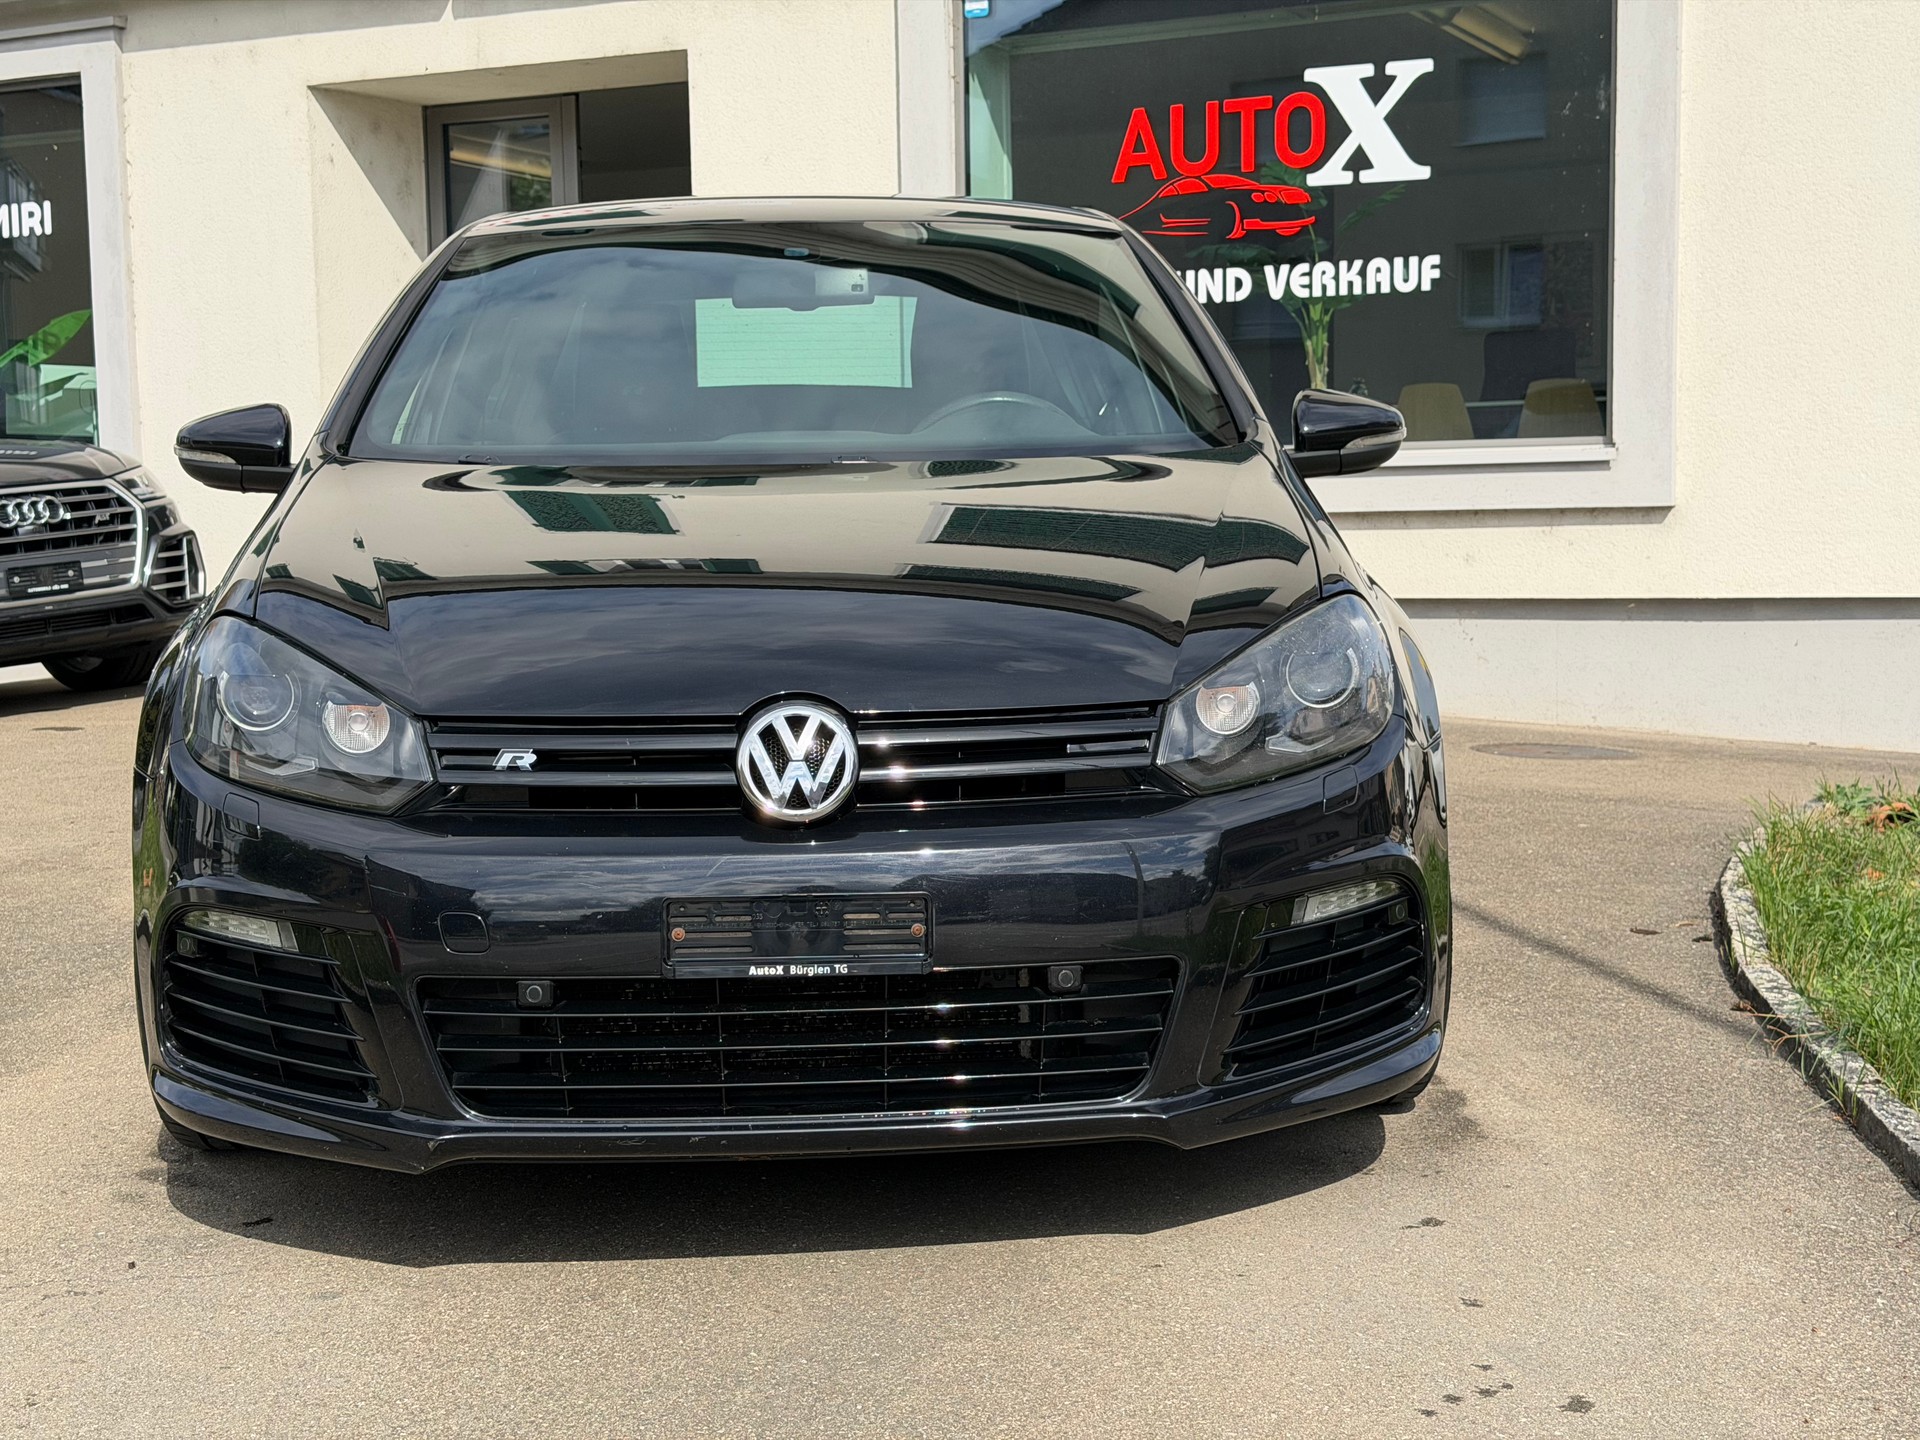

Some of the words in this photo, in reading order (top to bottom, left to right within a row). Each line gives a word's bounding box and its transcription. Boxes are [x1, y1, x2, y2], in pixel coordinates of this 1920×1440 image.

[1264, 254, 1441, 301] VERKAUF
[493, 748, 538, 772] R
[749, 712, 847, 810] VW
[748, 965, 784, 976] AutoX
[789, 964, 831, 976] Bürglen
[833, 964, 848, 974] TG
